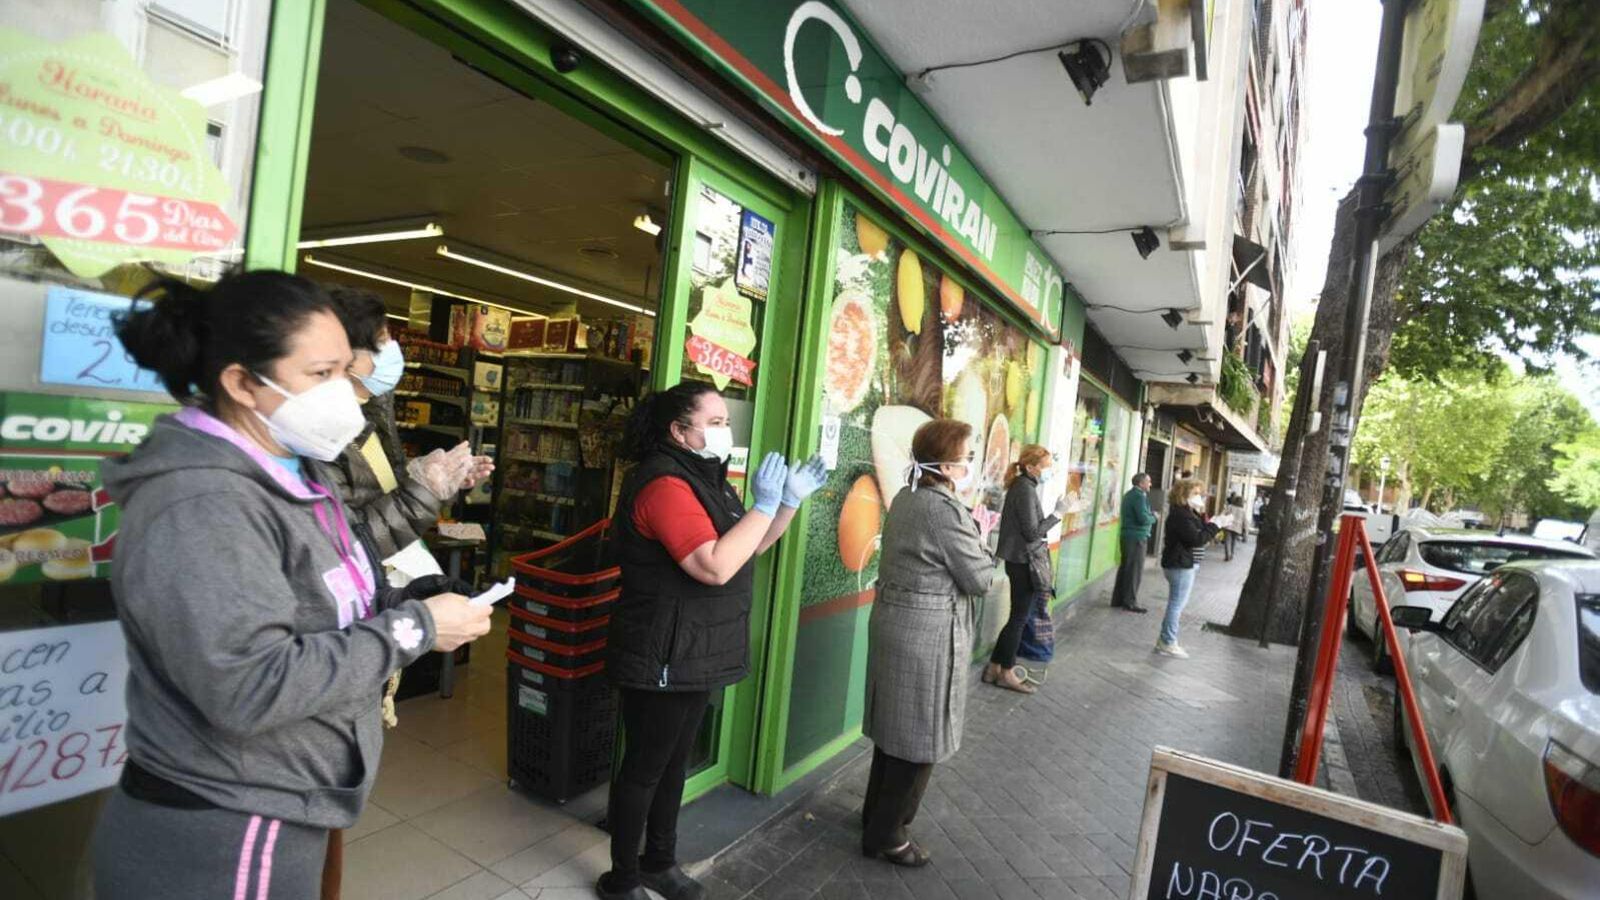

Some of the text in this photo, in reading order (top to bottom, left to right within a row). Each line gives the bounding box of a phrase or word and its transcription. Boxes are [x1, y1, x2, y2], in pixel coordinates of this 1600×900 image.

[0, 174, 160, 243] 365
[696, 341, 734, 376] 365
[80, 672, 109, 695] a
[1208, 811, 1391, 895] OFERTA
